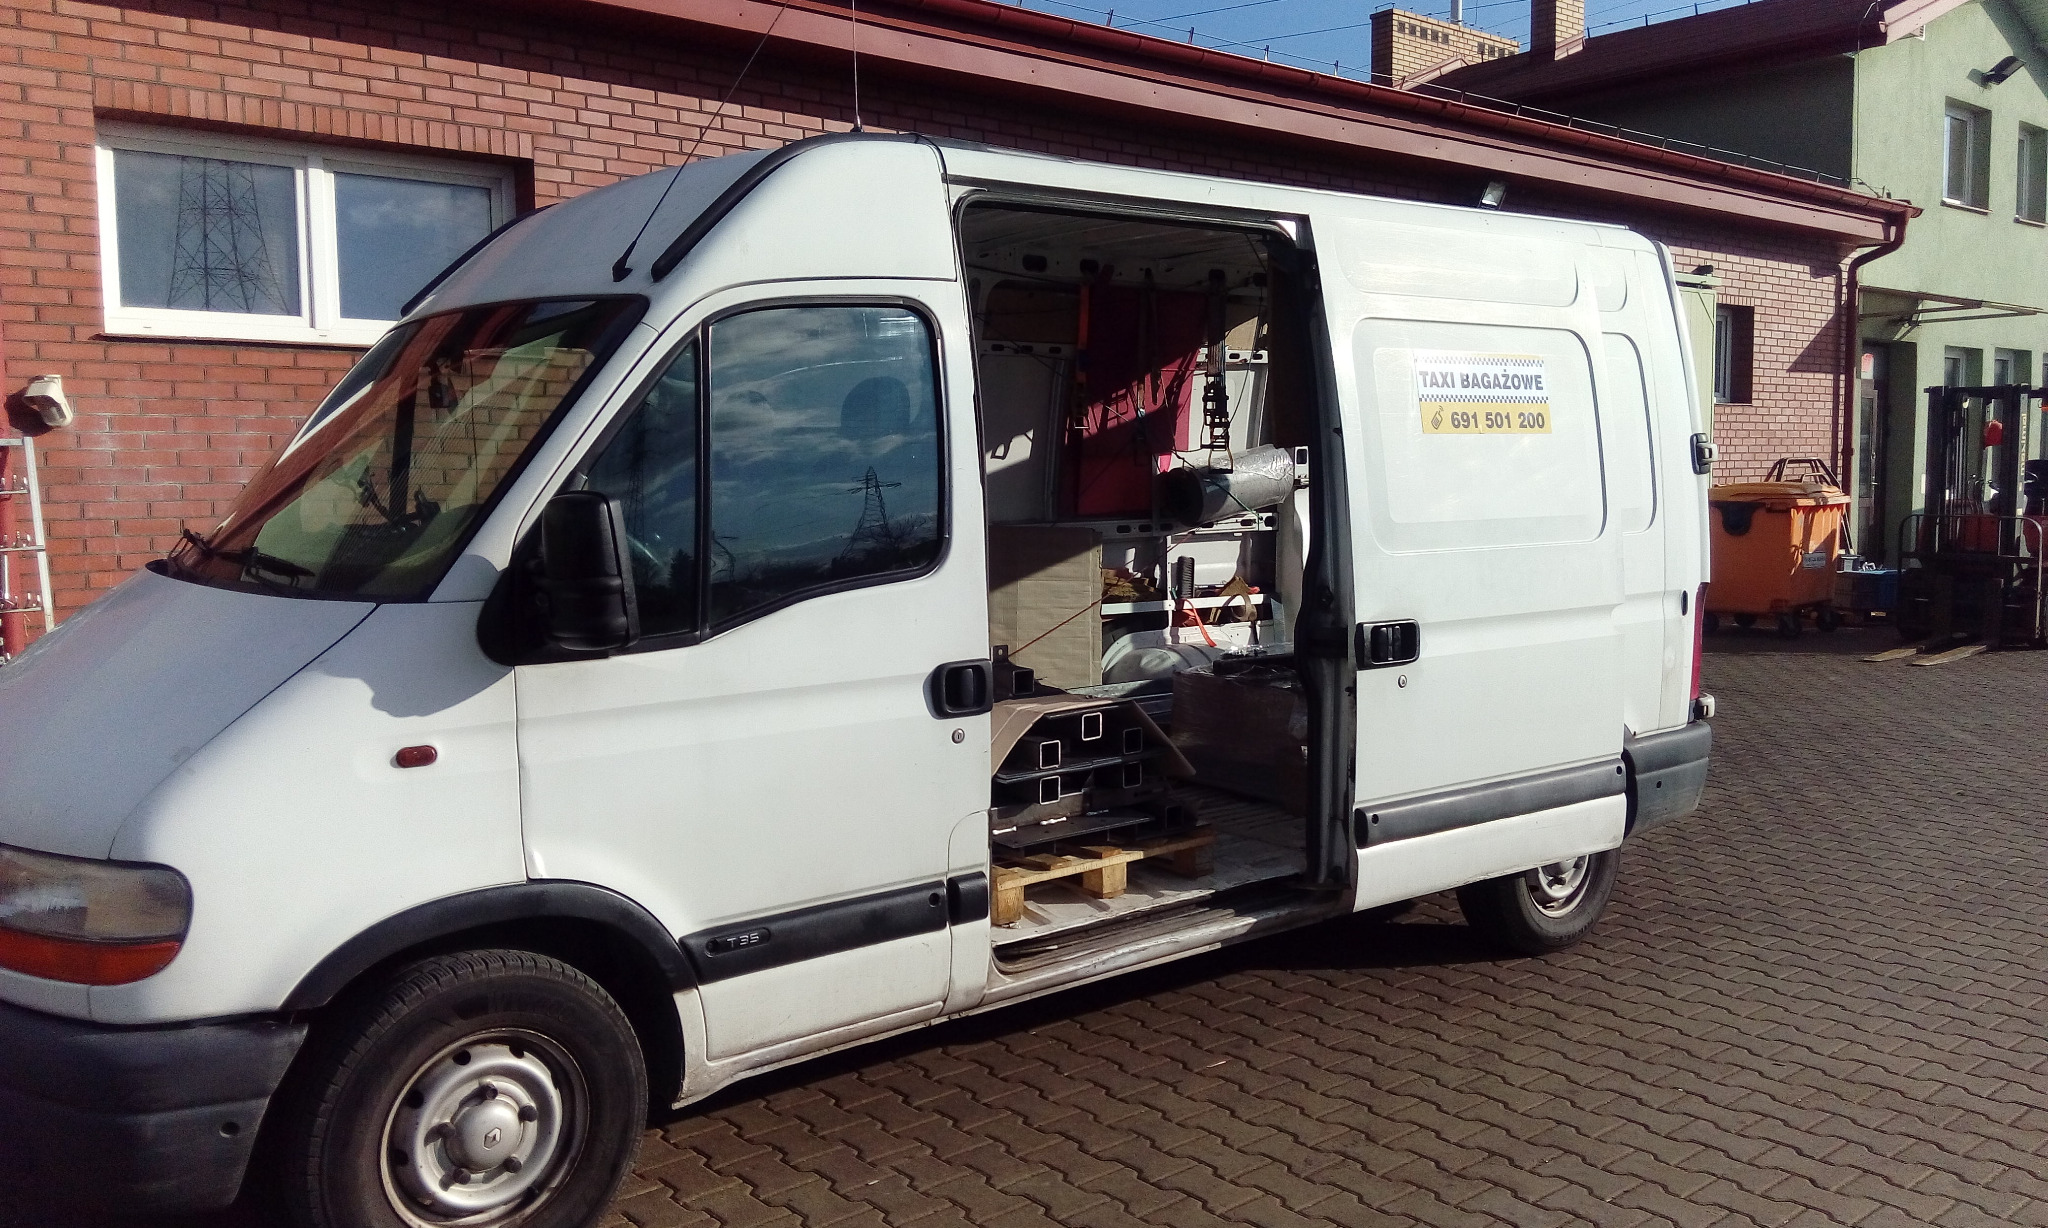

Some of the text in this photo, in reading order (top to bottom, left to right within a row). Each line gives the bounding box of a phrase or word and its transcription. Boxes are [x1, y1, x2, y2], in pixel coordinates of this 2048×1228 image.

[1419, 369, 1544, 390] TAXI BAGAŻOWE
[1451, 411, 1545, 429] 691 501 200
